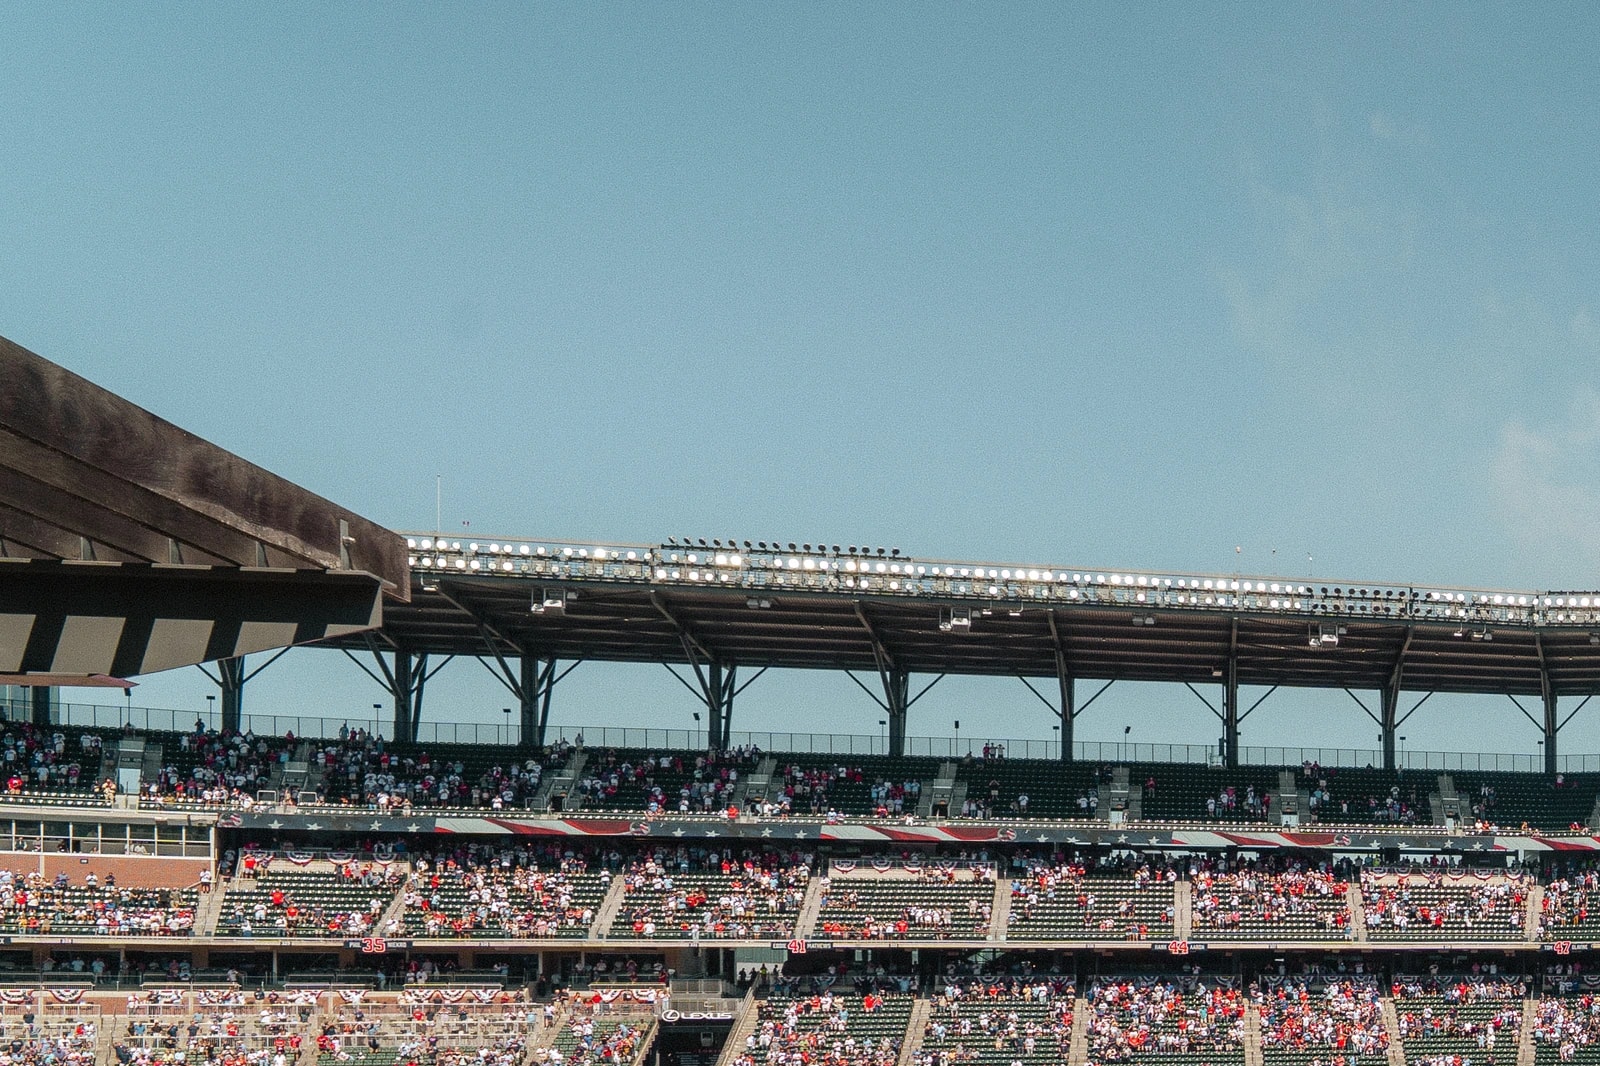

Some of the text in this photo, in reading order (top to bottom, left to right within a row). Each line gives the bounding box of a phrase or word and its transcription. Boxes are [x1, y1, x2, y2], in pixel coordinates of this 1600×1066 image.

[362, 938, 386, 953] 35
[787, 939, 807, 953] 41
[1168, 941, 1189, 954] 44
[1554, 941, 1571, 954] 47
[681, 1012, 732, 1020] LEXUS
